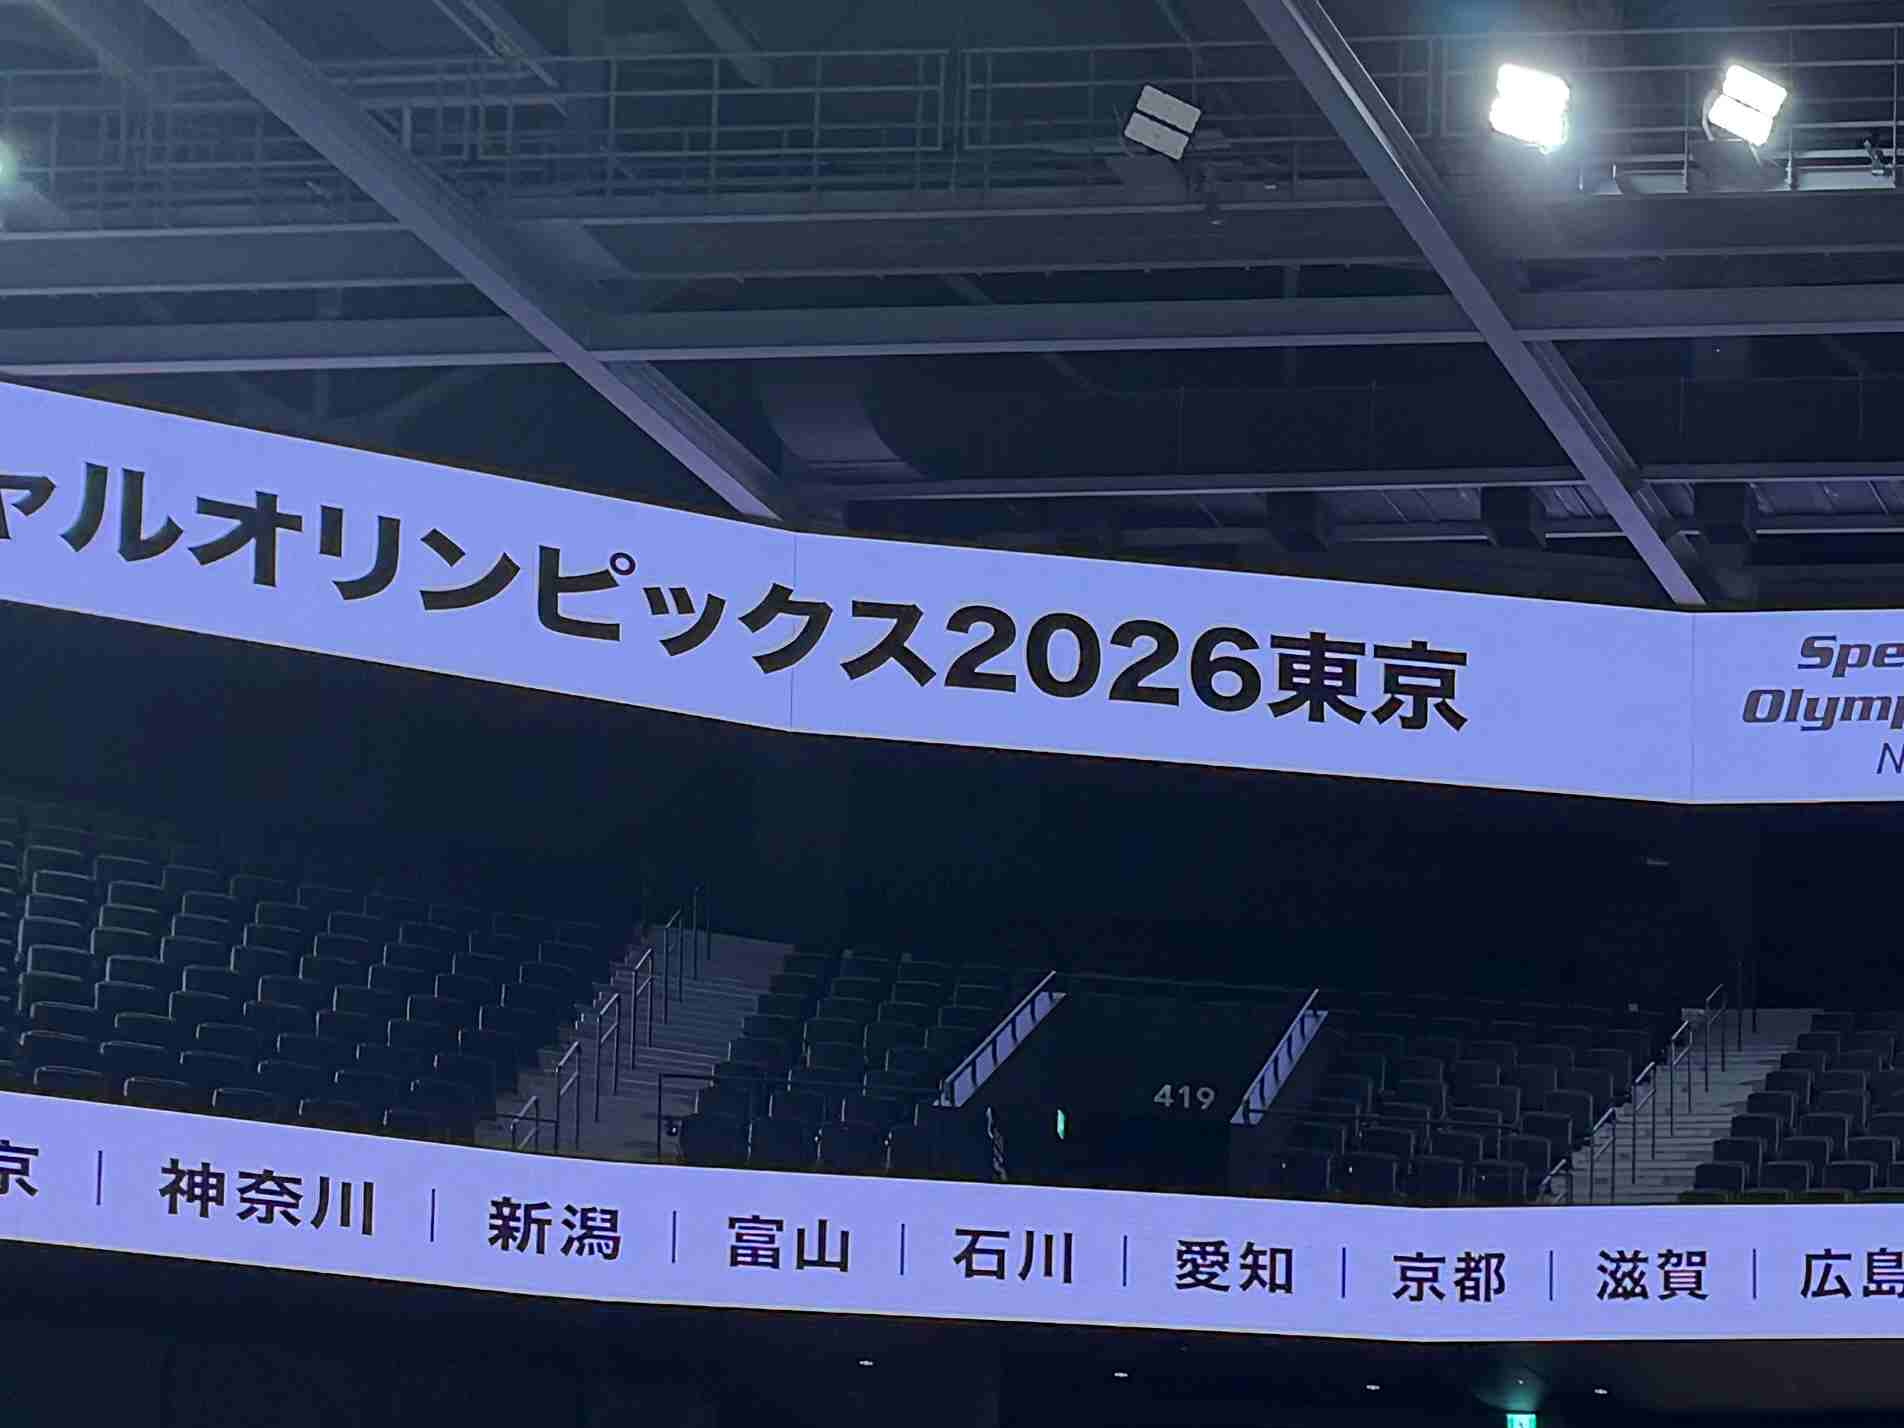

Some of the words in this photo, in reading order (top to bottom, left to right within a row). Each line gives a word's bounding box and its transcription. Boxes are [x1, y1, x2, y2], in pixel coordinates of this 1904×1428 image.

[1153, 1084, 1215, 1110] 419
[158, 1157, 374, 1236] 神奈川
[487, 1196, 622, 1262] 新潟
[727, 1214, 850, 1273] 富山
[952, 1228, 1074, 1285] 石川
[1175, 1239, 1294, 1295] 愛知
[1392, 1251, 1507, 1304] 京都
[1596, 1248, 1709, 1301] 滋賀
